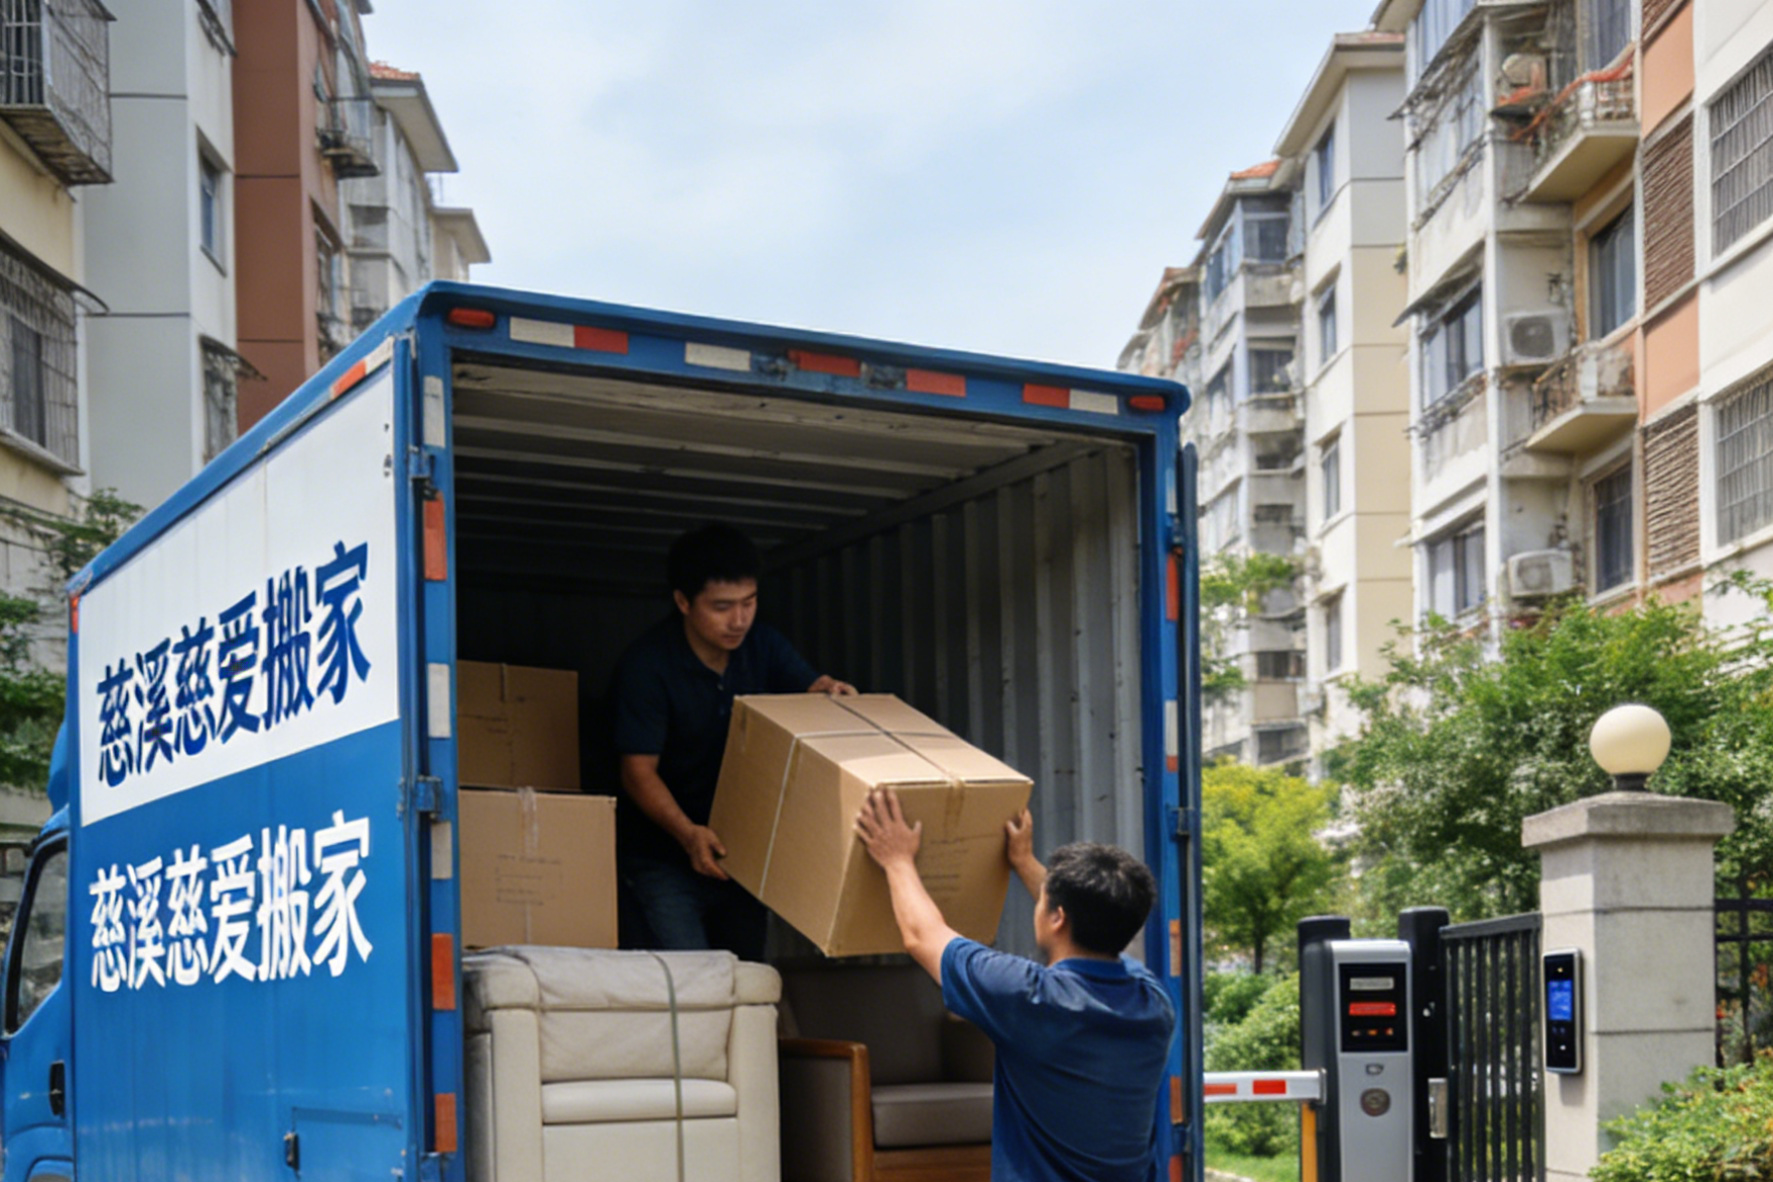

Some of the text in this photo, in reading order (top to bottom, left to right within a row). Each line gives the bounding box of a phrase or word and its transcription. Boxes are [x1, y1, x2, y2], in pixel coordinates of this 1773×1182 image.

[97, 540, 372, 788] 慈溪慈爱搬家
[89, 809, 373, 992] 慈溪慈爱搬家
